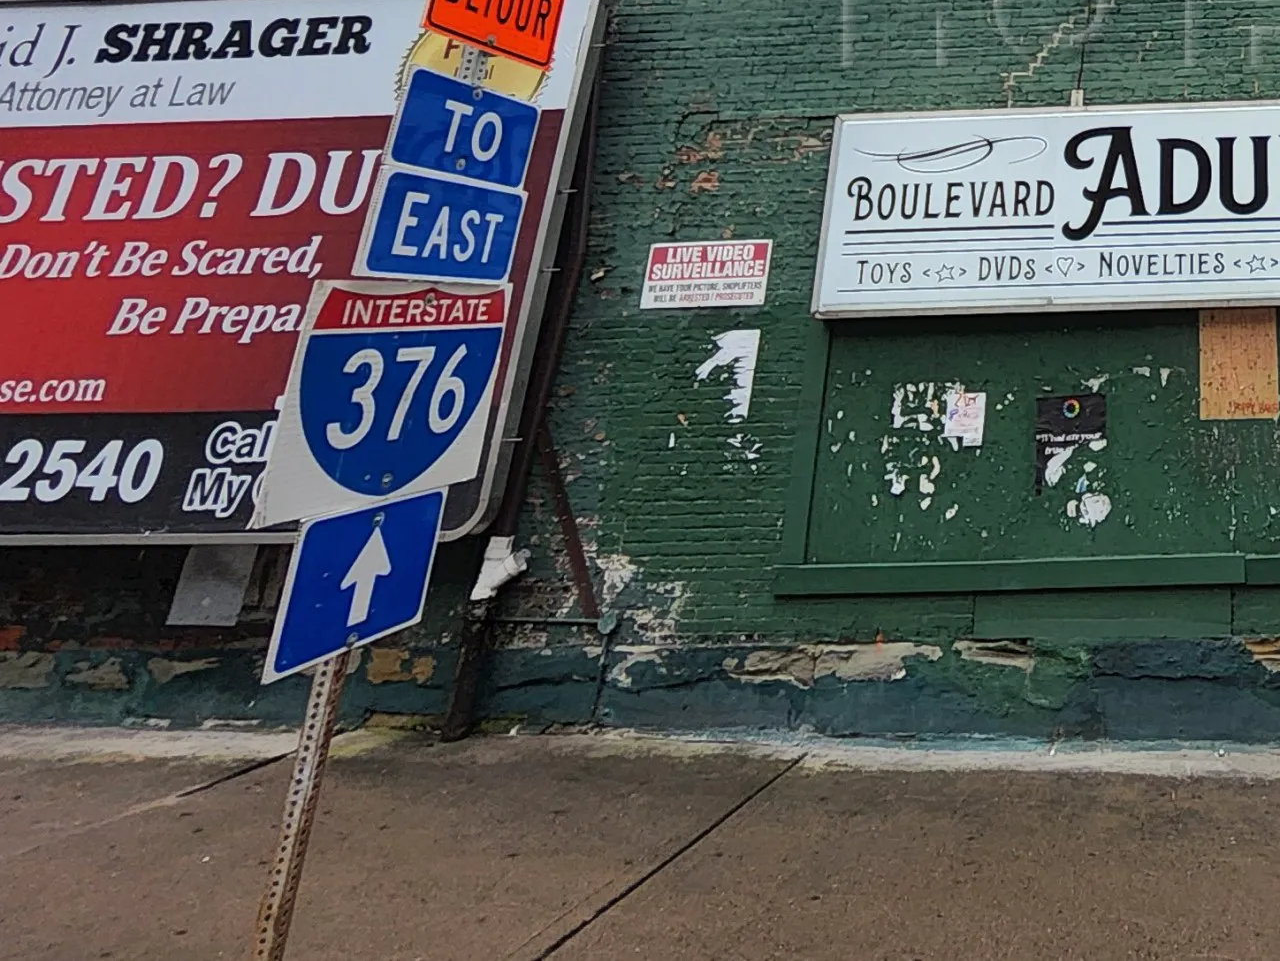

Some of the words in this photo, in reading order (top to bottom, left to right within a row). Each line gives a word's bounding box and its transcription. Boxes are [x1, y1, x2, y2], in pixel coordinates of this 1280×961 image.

[43, 25, 82, 78] J.
[95, 15, 373, 64] SHRAGER
[0, 80, 122, 117] Attorney
[129, 77, 164, 108] at
[168, 75, 236, 108] Law
[443, 99, 504, 163] TO
[0, 153, 243, 224] STED?
[847, 175, 1055, 222] BOULEVARD
[391, 192, 503, 264] EAST
[0, 240, 109, 279] Don't
[108, 240, 169, 277] Be
[170, 235, 323, 279] Scared,
[651, 259, 765, 280] SURVEILLANCE
[666, 247, 703, 263] LIVE
[706, 244, 756, 262] VIDEO
[856, 259, 912, 285] TOYS
[1098, 251, 1225, 279] NOVELTIES
[106, 298, 167, 335] Be
[170, 297, 309, 344] Prepa
[341, 298, 490, 326] INTERSTATE
[325, 342, 469, 451] 376
[0, 438, 164, 503] 2540
[182, 468, 252, 518] My
